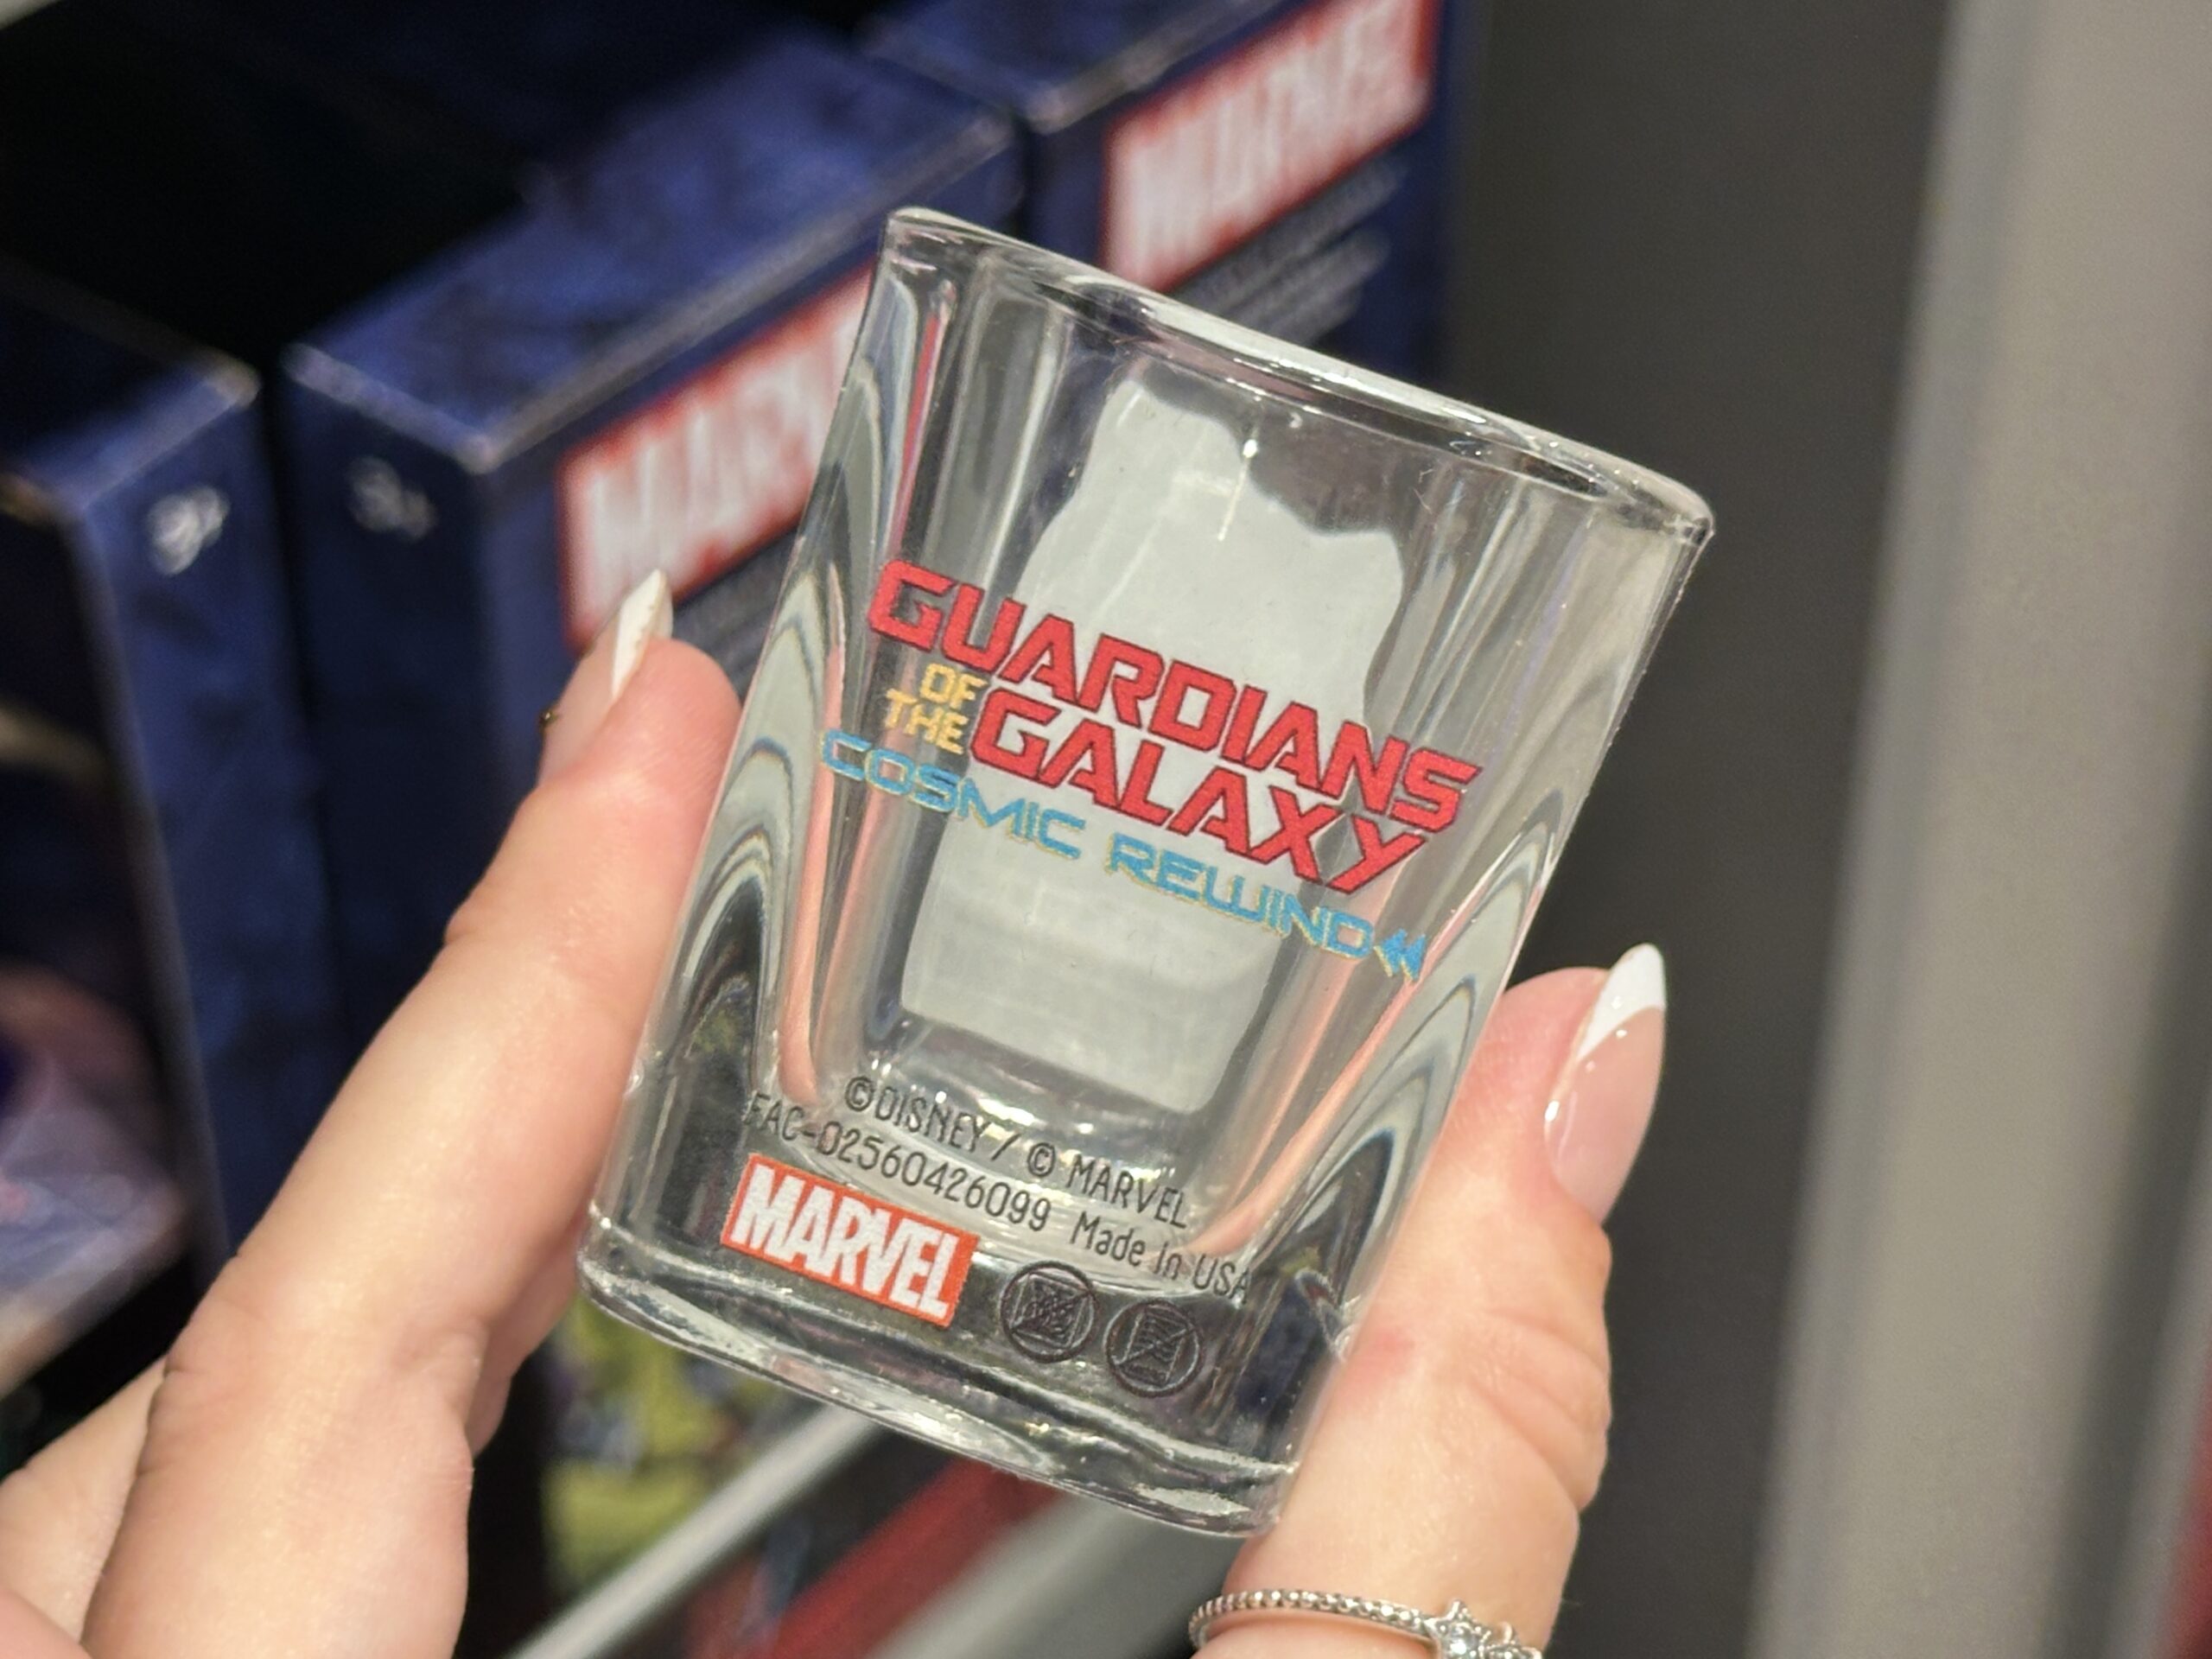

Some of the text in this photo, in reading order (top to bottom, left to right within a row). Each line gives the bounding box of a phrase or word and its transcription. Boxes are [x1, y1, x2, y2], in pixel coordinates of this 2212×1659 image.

[867, 559, 1484, 833] GUARDIANS
[885, 688, 969, 755] THE
[919, 663, 988, 709] OF
[822, 728, 1374, 959] COSMIC REWIND
[969, 687, 1429, 895] GALAXY
[730, 1162, 960, 1319] MARVEL
[1065, 1154, 1187, 1229] MARVEL
[1069, 1211, 1147, 1268] Made
[1154, 1242, 1181, 1281] in
[1192, 1254, 1251, 1304] USA
